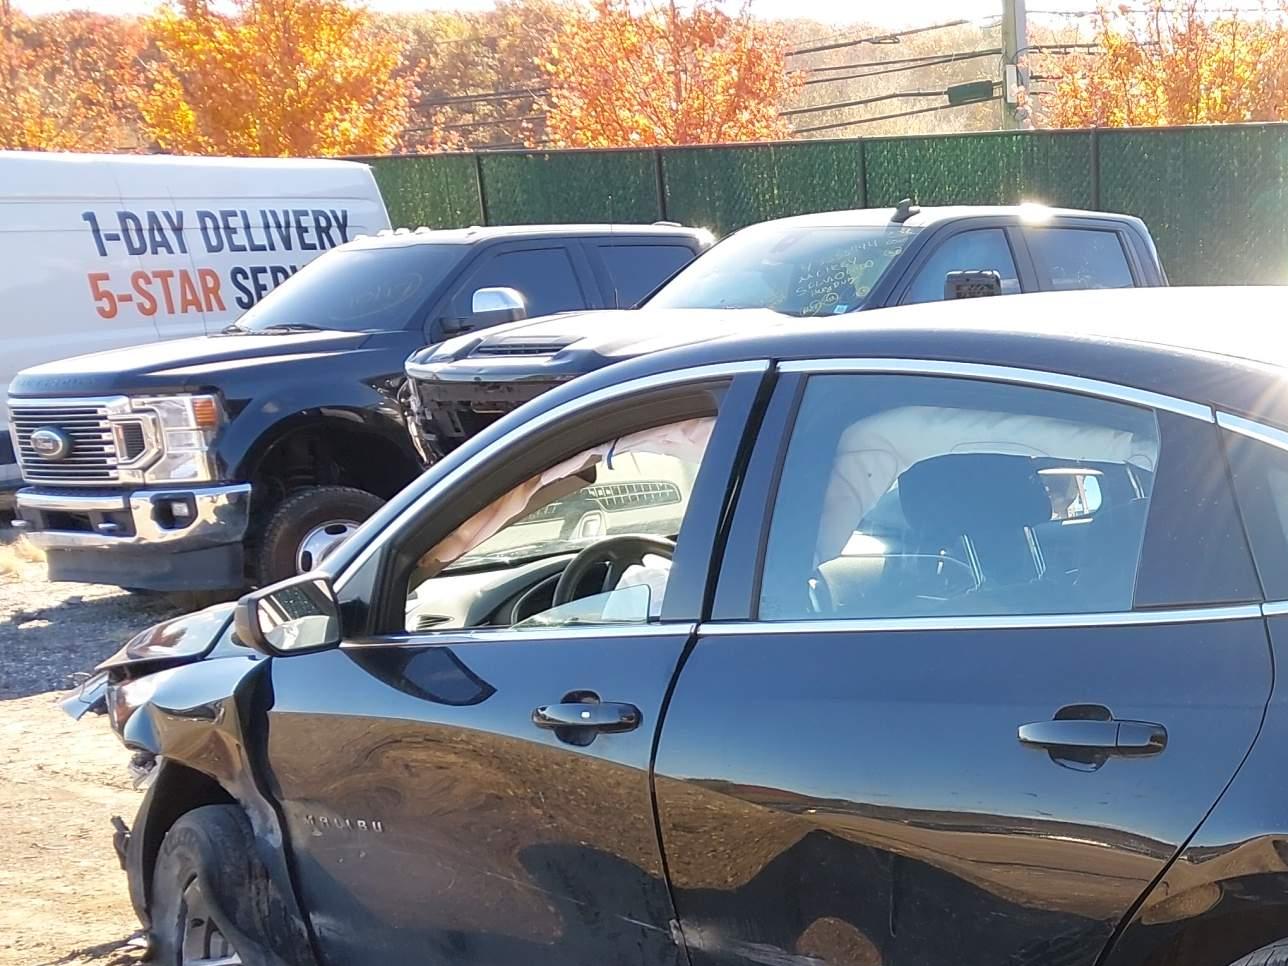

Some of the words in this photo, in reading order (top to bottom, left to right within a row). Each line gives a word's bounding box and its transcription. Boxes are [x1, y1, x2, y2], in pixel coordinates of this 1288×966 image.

[82, 210, 189, 257] 1-DAY
[196, 209, 349, 253] DELIVERY
[88, 267, 226, 319] 5-STAR
